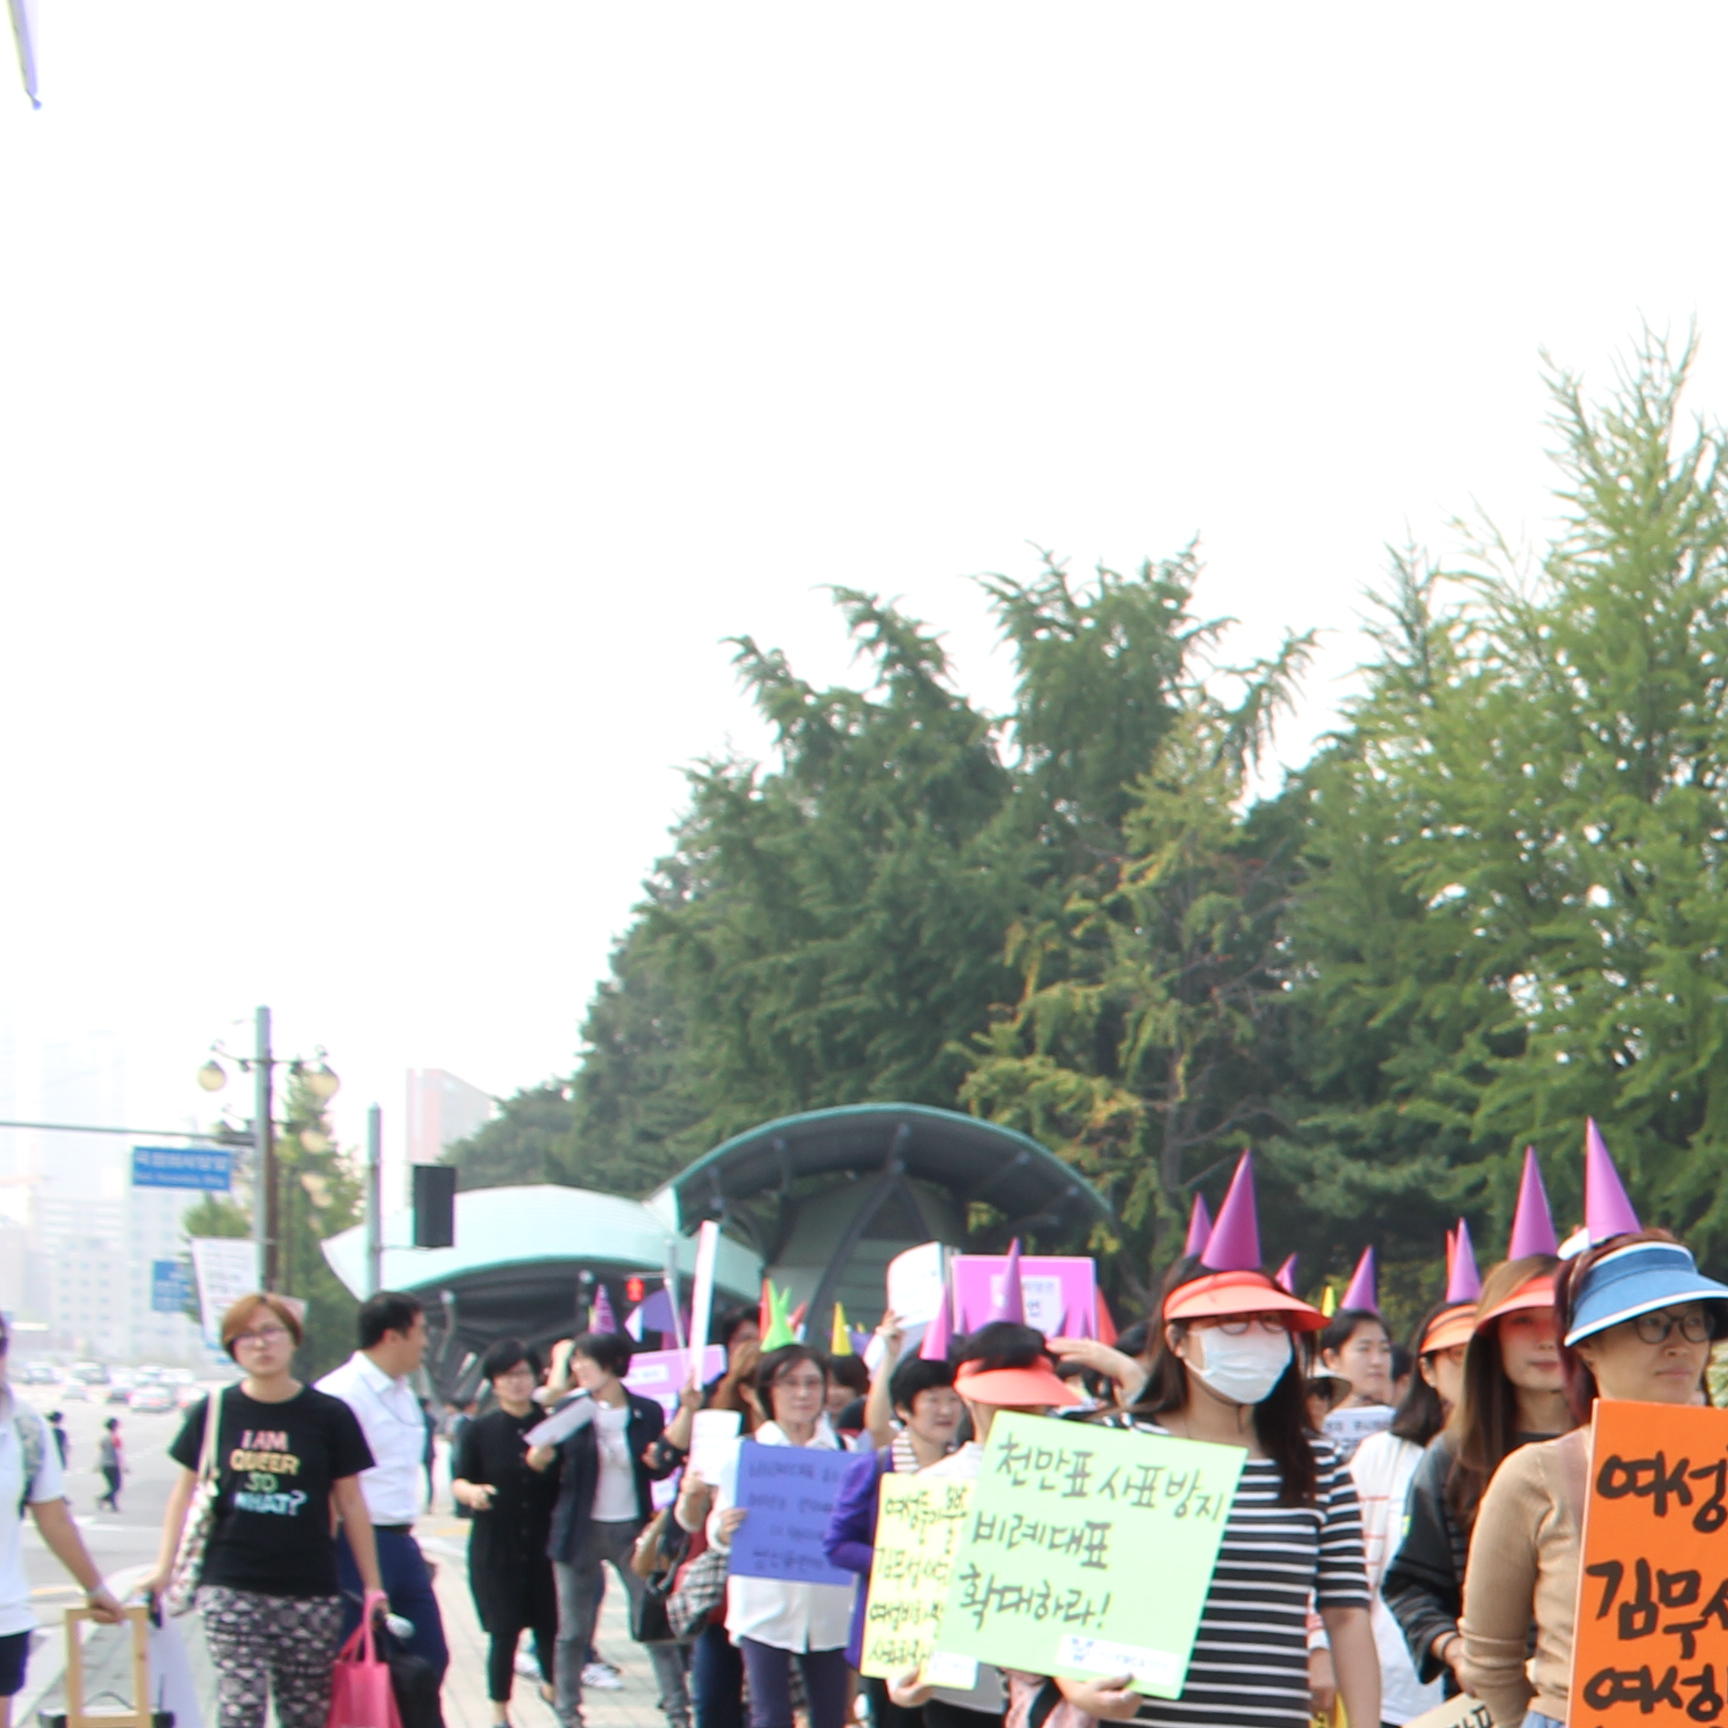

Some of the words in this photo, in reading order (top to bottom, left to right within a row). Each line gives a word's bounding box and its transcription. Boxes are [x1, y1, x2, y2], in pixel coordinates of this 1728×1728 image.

[241, 1429, 253, 1449] I
[252, 1430, 288, 1451] AM
[230, 1448, 300, 1475] QUEER
[997, 1432, 1094, 1498] 천만표
[244, 1471, 279, 1494] SO
[234, 1489, 308, 1516] WHAT?
[972, 1510, 1113, 1570] 비례대표
[959, 1562, 1112, 1630] 확대하라!
